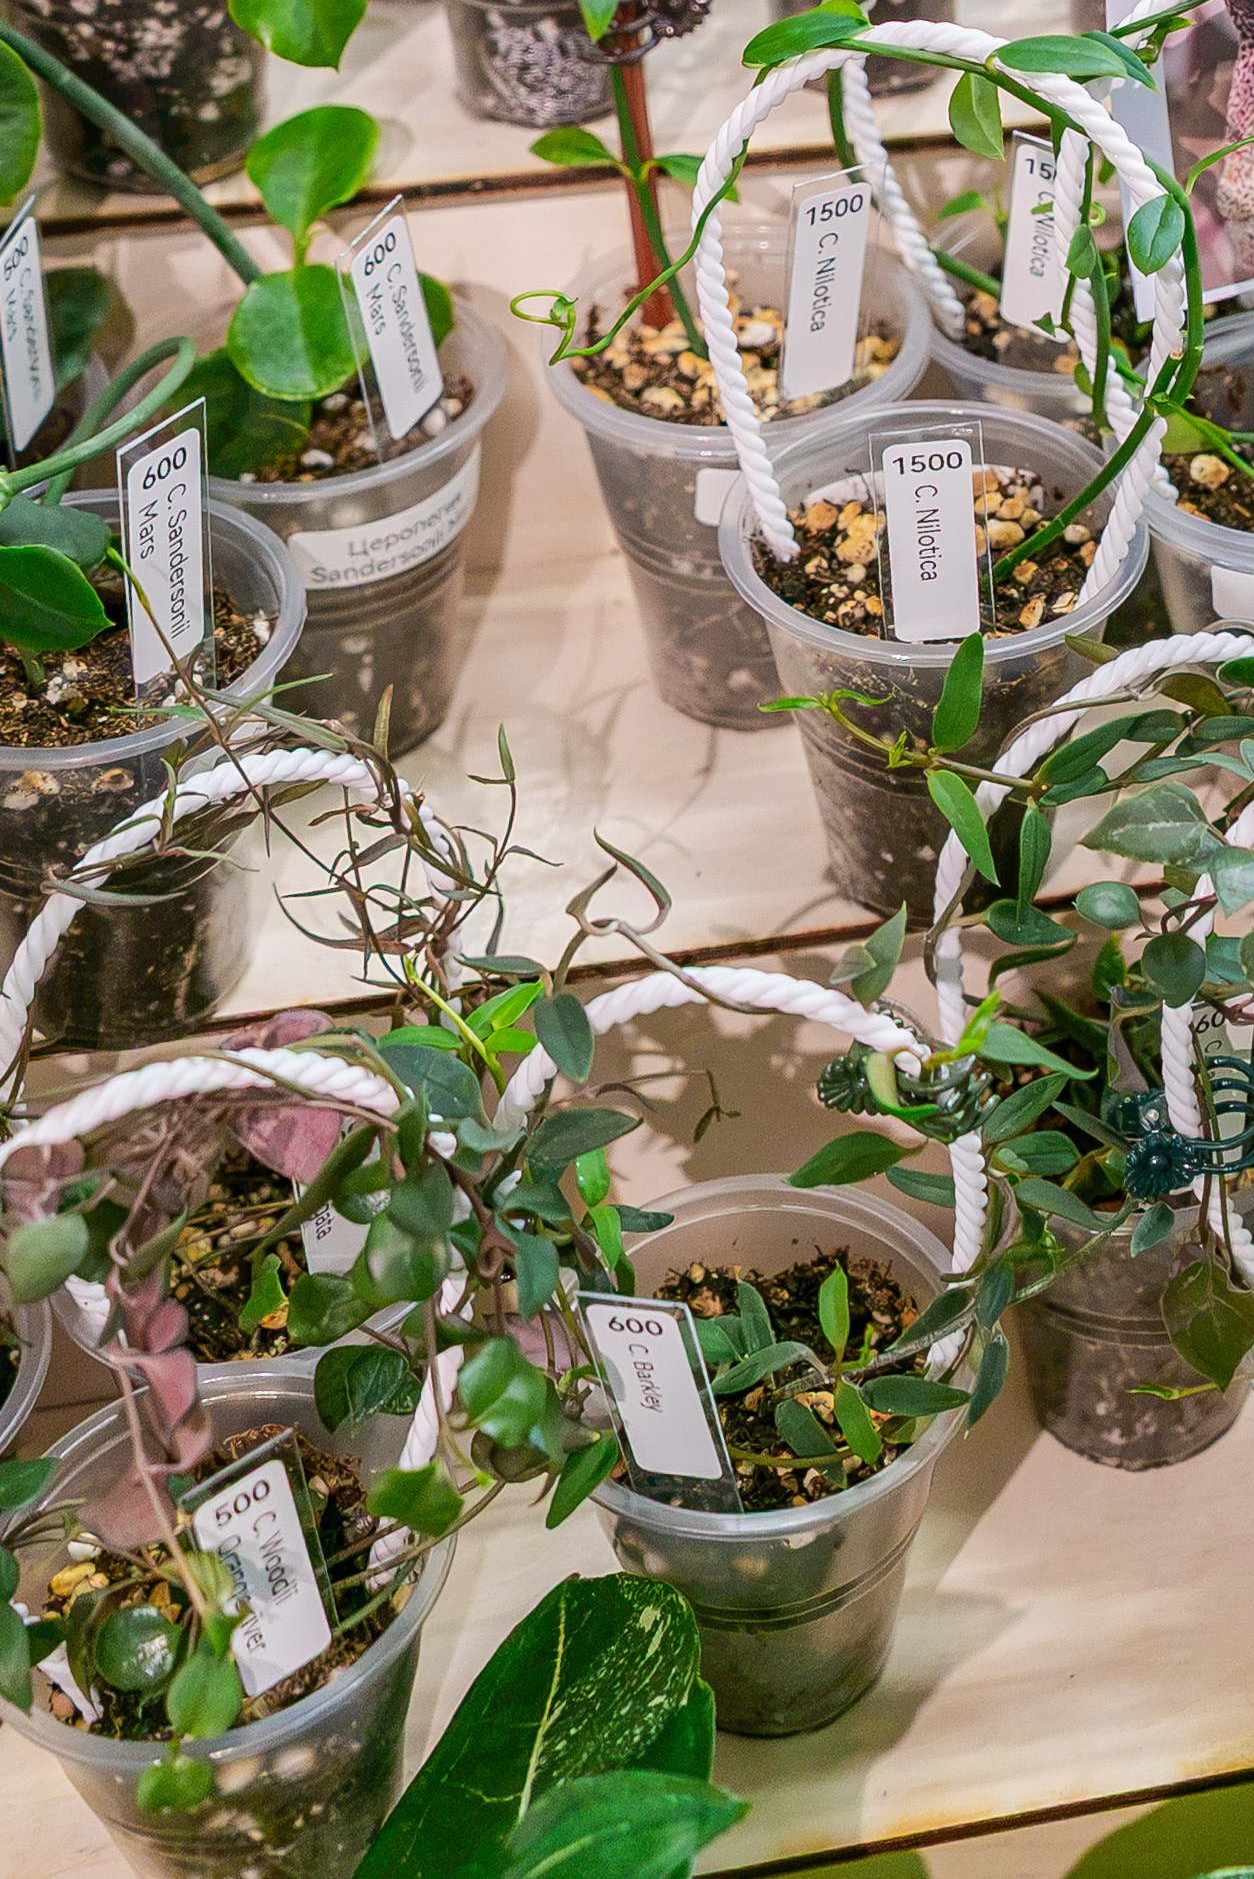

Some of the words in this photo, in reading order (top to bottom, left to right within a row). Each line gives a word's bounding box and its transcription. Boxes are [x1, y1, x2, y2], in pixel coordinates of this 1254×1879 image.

[806, 194, 864, 226] 1500
[364, 232, 397, 276] 600
[817, 232, 839, 255] C.
[365, 282, 387, 336] Mars
[810, 256, 837, 334] Nilotica
[391, 285, 425, 394] Sandersonii
[142, 446, 187, 490] 600
[892, 451, 963, 475] 1500
[914, 484, 938, 504] C.
[138, 499, 158, 560] Mars
[915, 508, 942, 582] Nilotica
[168, 508, 191, 640] Sandersonii
[608, 1316, 663, 1336] 600
[633, 1361, 663, 1413] Barkley
[215, 1479, 270, 1527] 500
[259, 1529, 299, 1606] Woodii
[240, 1610, 266, 1653] iver
